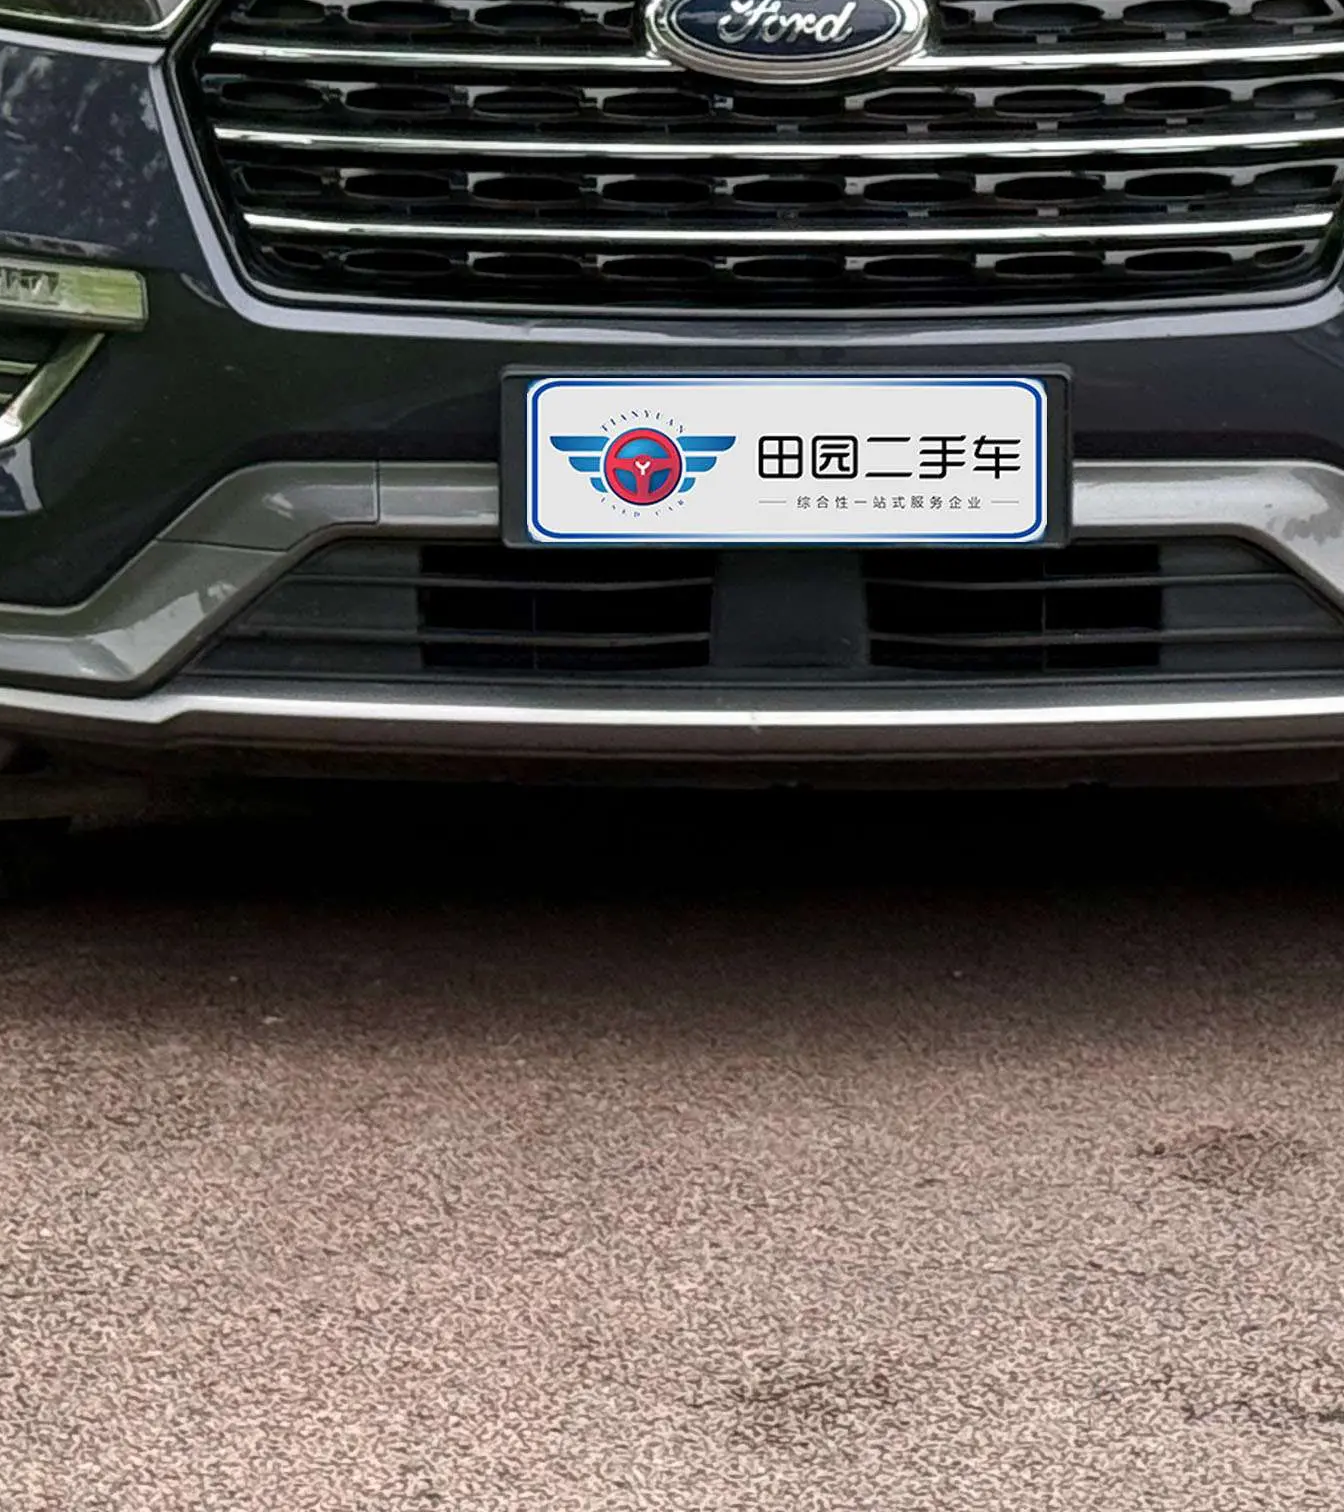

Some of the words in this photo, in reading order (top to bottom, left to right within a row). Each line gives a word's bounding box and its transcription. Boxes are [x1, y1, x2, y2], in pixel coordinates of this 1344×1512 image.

[758, 434, 1021, 480] 田园二手车
[796, 494, 982, 510] 综合性一站式服务企业
